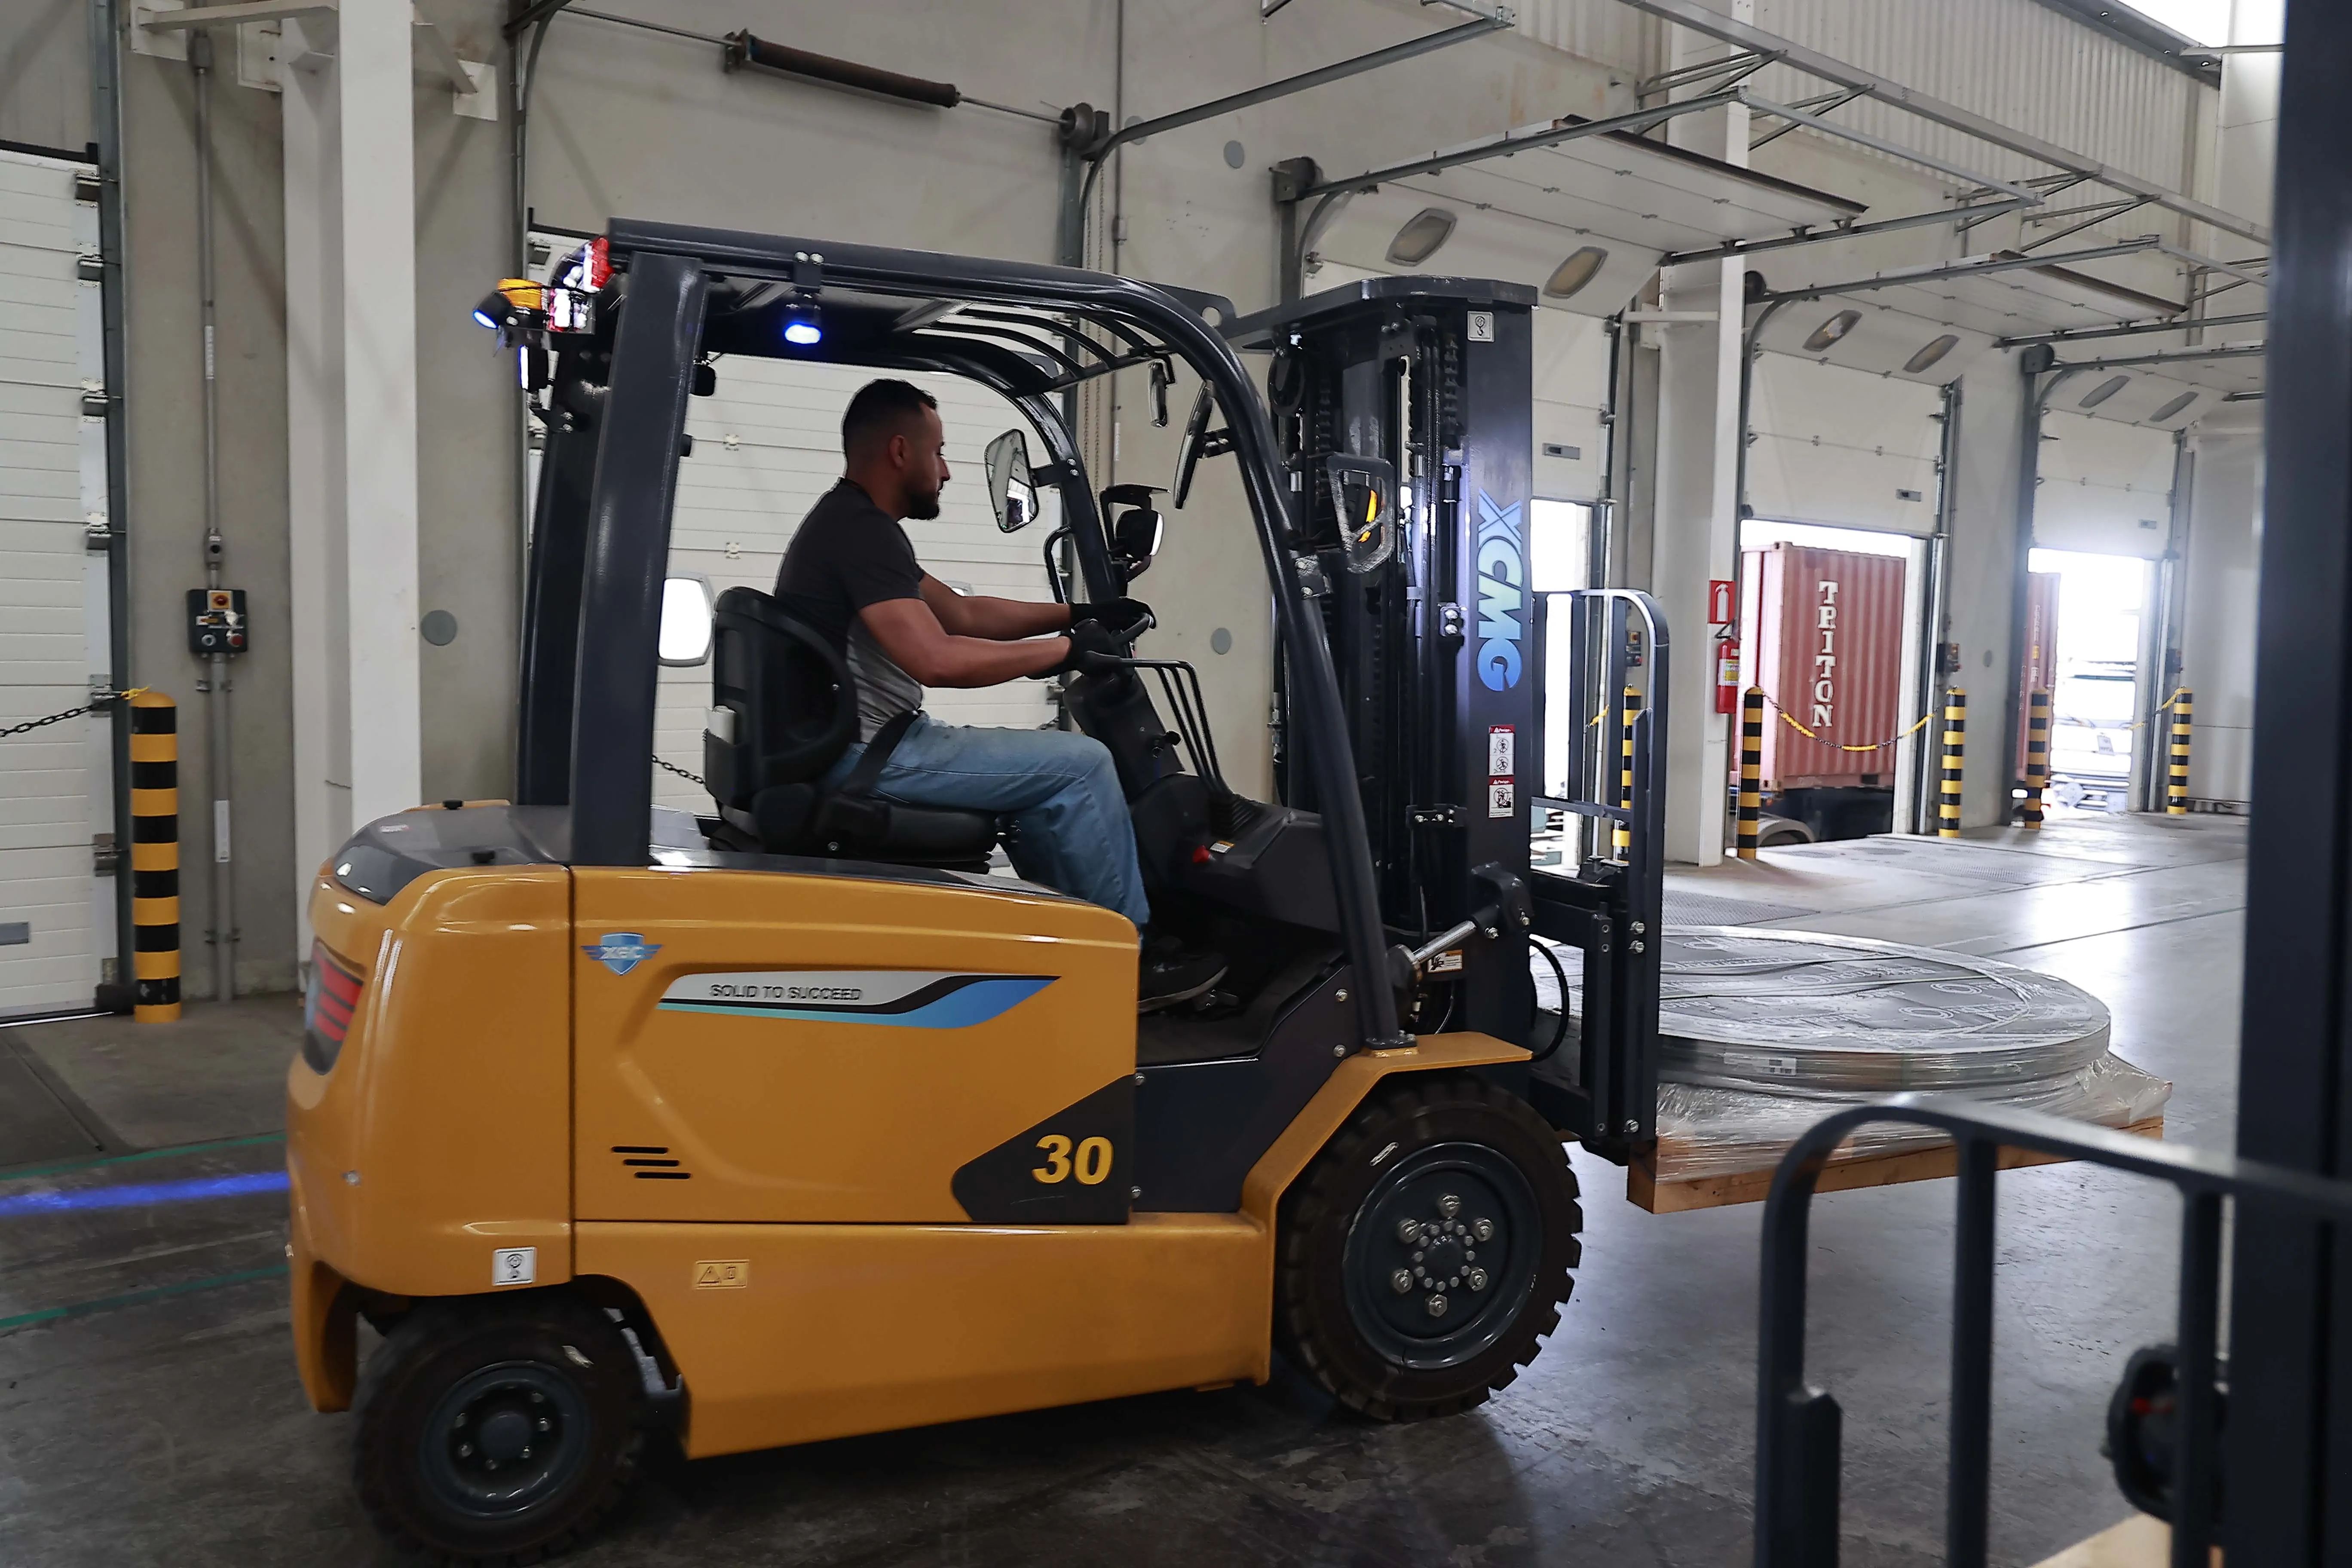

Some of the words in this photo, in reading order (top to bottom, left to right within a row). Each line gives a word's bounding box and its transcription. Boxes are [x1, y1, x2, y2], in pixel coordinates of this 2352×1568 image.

[1477, 487, 1523, 692] XCMG
[1811, 580, 1839, 727] TRITON
[710, 984, 759, 998] SOLID
[763, 986, 784, 999] TO
[788, 986, 862, 1001] SUCCEED
[1032, 1134, 1114, 1185] 30
